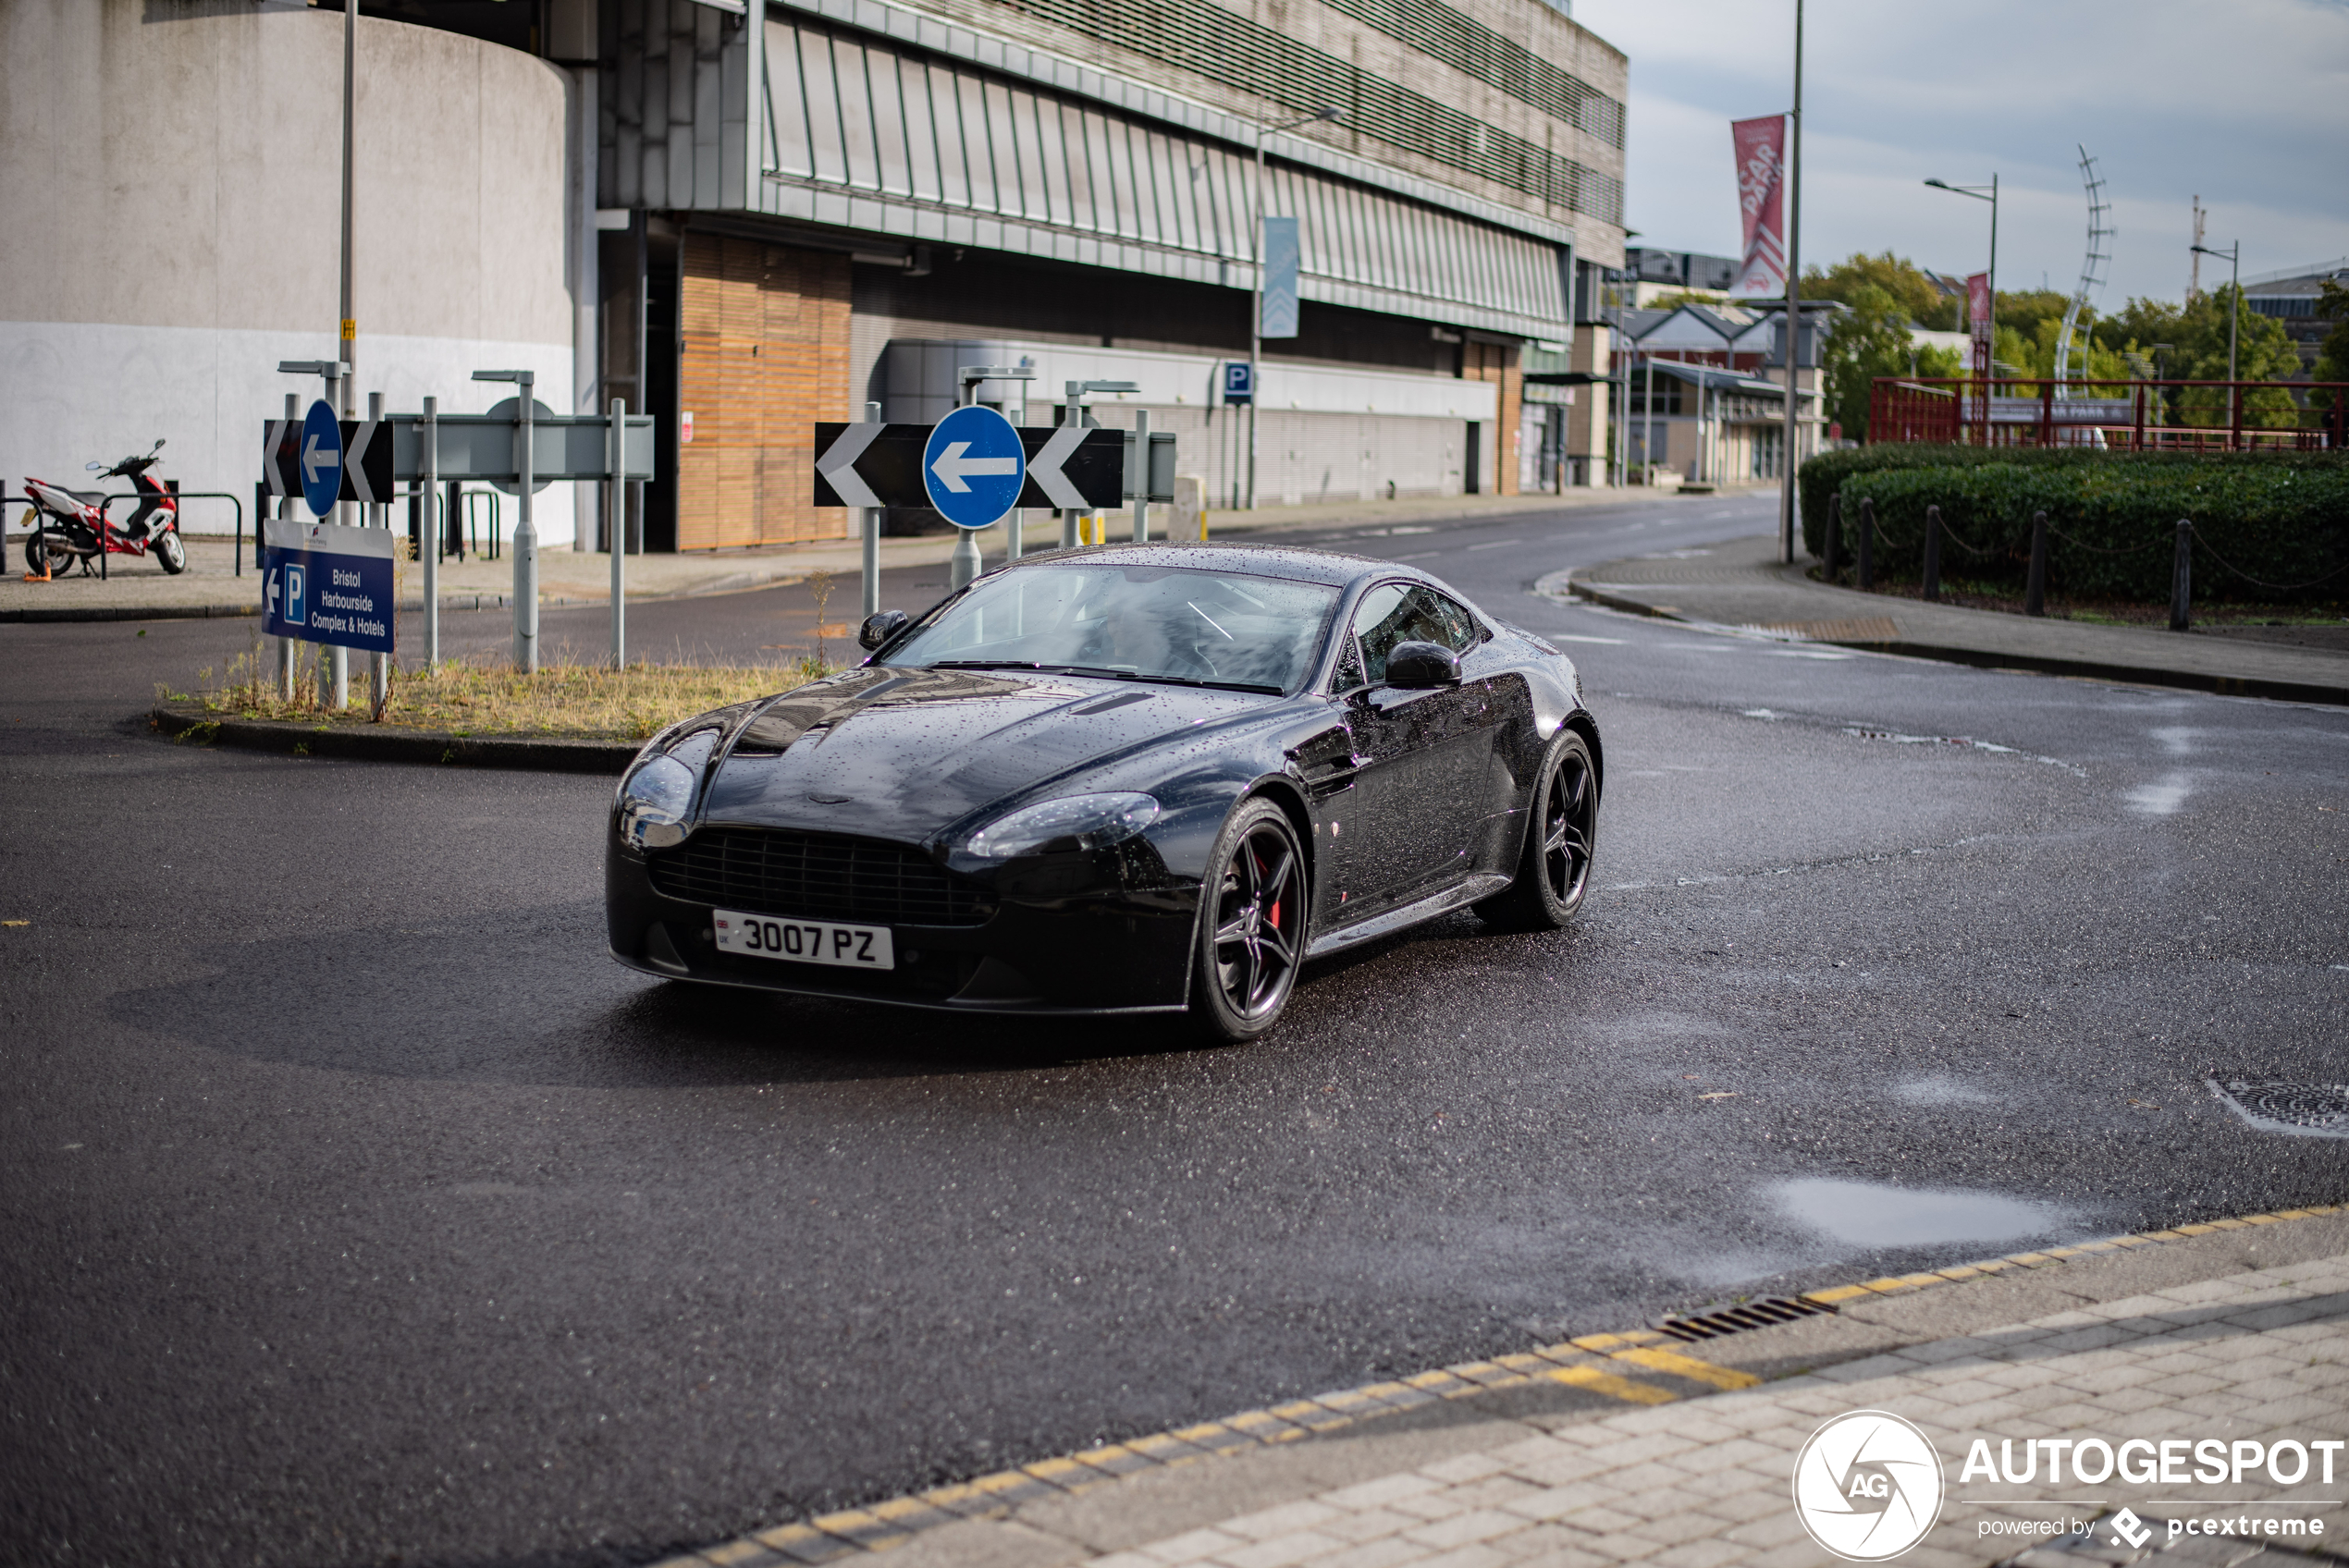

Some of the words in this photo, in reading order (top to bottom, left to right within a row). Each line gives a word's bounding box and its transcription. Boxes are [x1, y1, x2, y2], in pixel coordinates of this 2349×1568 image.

[1739, 143, 1777, 192] CAR
[343, 321, 355, 337] H
[1229, 367, 1248, 388] P
[333, 568, 361, 588] Bristol
[289, 570, 301, 617] P
[322, 590, 373, 612] Harbourside
[312, 611, 347, 634] Complex
[349, 616, 355, 633] &
[357, 617, 386, 637] Hotels
[719, 935, 730, 944] UK
[744, 919, 822, 957] 3007
[833, 929, 876, 962] PZ
